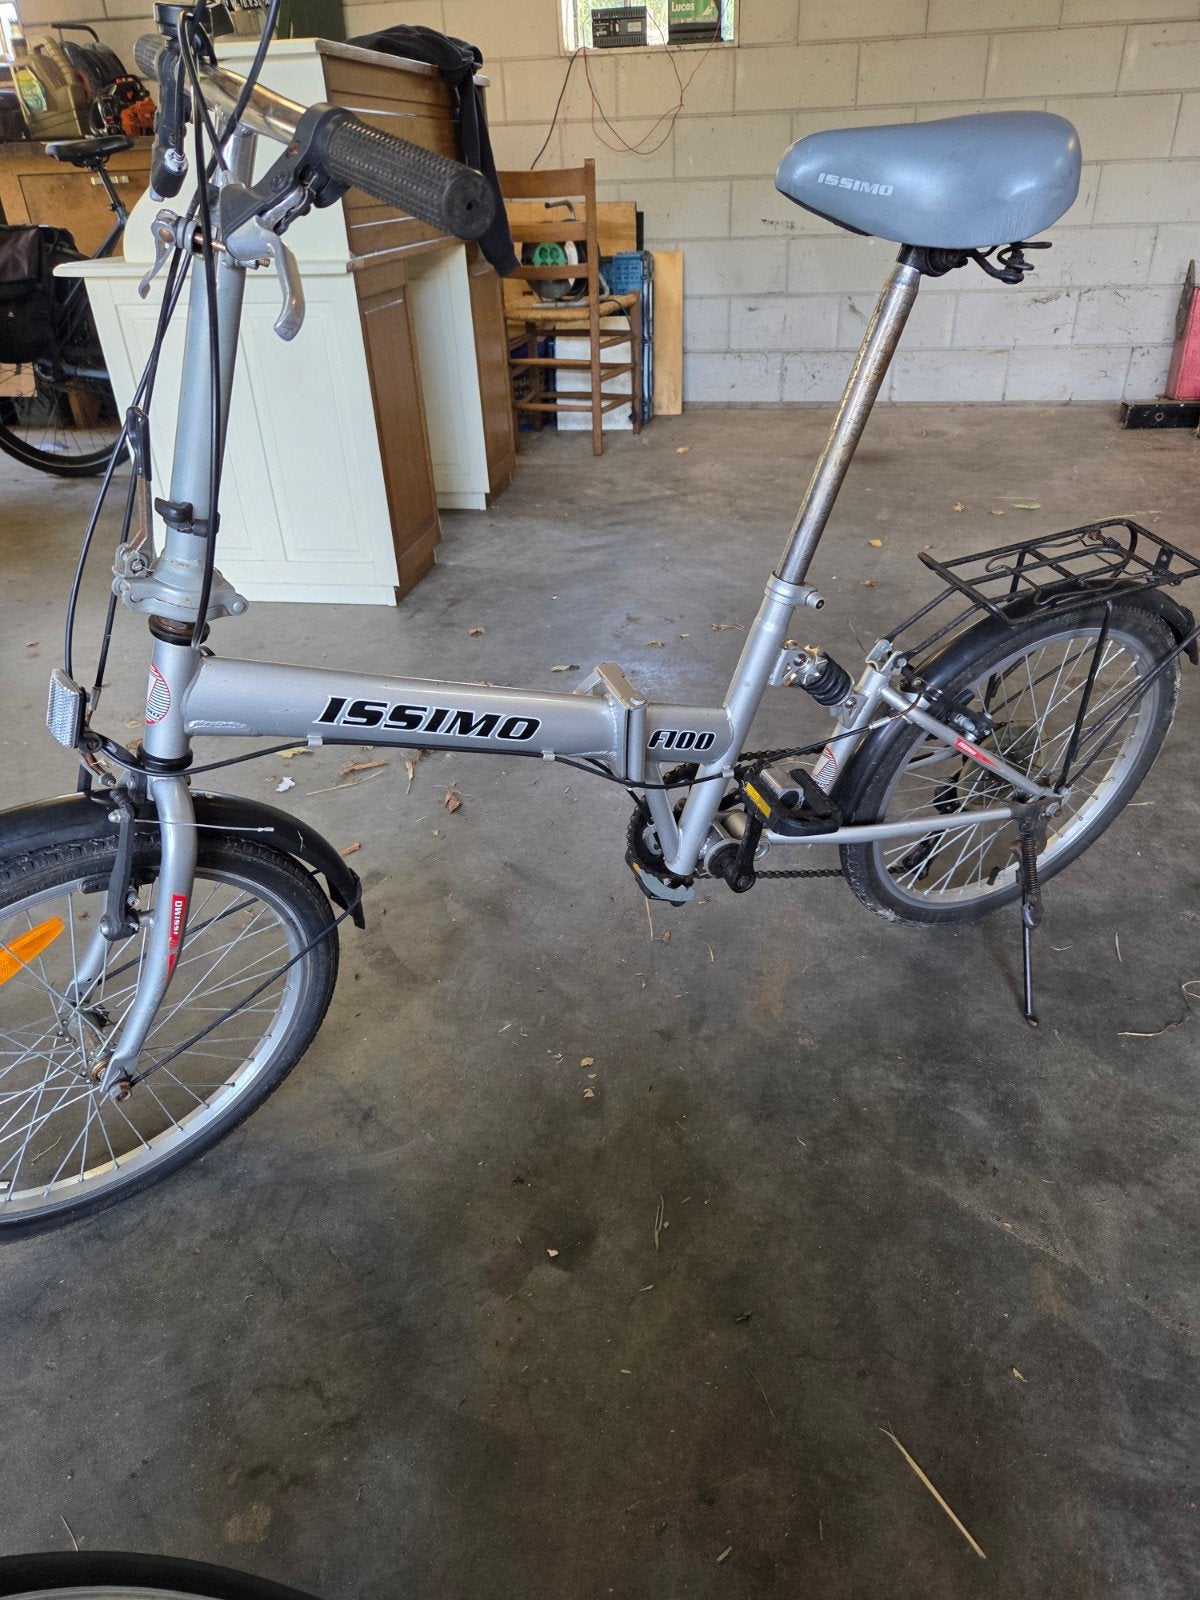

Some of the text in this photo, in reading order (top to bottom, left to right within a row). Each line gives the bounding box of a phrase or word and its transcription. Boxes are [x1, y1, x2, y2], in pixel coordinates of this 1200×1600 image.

[671, 1, 695, 12] Lucas
[817, 172, 894, 196] ISSIMO
[313, 695, 542, 741] ISSIMO
[647, 728, 717, 751] F100
[173, 900, 183, 935] ISSIMO
